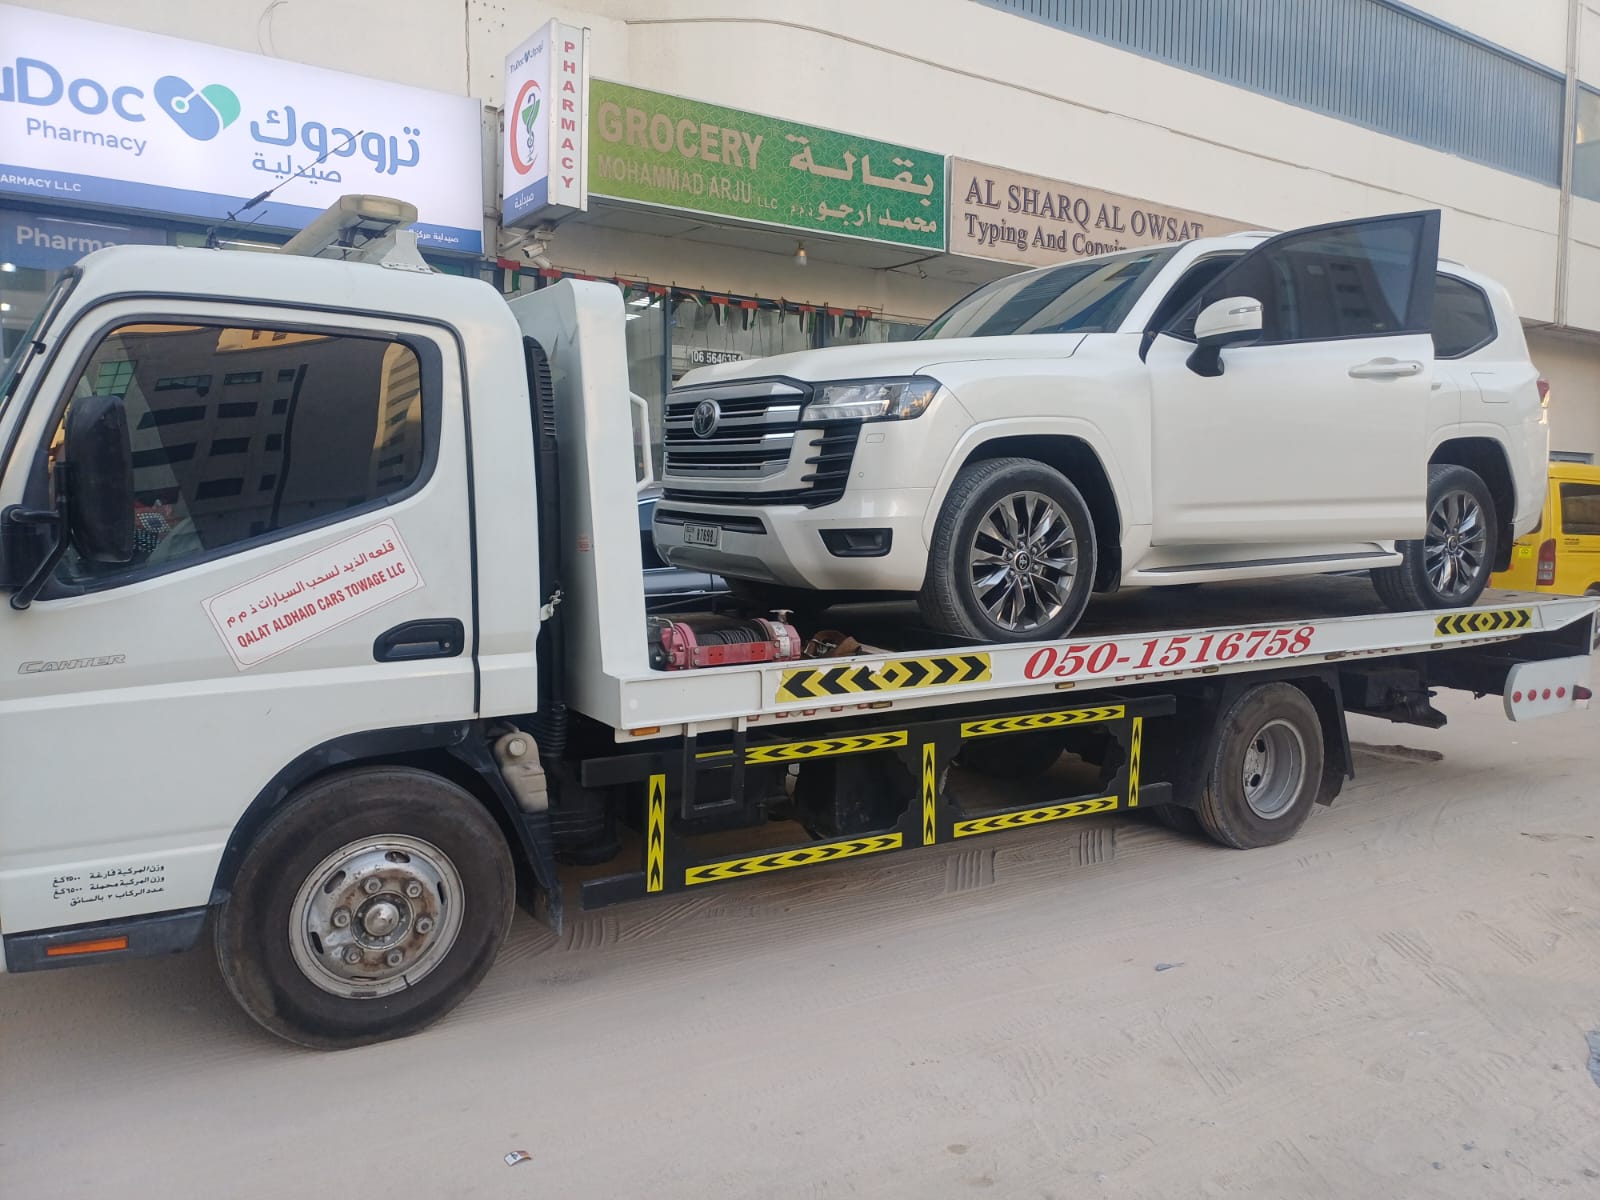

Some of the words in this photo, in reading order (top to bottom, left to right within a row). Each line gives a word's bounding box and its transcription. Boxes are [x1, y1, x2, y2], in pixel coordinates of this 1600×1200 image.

[560, 40, 576, 189] PHARMACY
[26, 117, 147, 157] Pharmacy
[250, 105, 420, 175] ترودوك
[599, 101, 763, 170] GROCERY
[54, 181, 82, 192] LLC
[252, 152, 342, 184] صيدلية
[598, 154, 704, 195] MOHAMMAD
[709, 176, 752, 204] ARJU
[757, 196, 778, 209] LLC
[785, 133, 934, 206] بقالة
[815, 201, 871, 226] ارجو
[879, 207, 937, 233] محمد
[964, 176, 1001, 209] AL
[1007, 184, 1090, 233] SHARQ
[1094, 203, 1126, 233] AL
[1130, 210, 1203, 242] OWSAT
[964, 212, 1028, 251] Typing
[1032, 225, 1068, 252] And
[258, 581, 305, 610] السيارات
[306, 565, 340, 590] لسحب
[237, 623, 272, 648] QALAT
[272, 603, 317, 632] ALDHAID
[317, 590, 345, 611] CARS
[344, 572, 387, 598] TOWAGE
[387, 562, 405, 580] LLC
[17, 653, 126, 675] CANTER
[1023, 626, 1315, 680] 050-1516758
